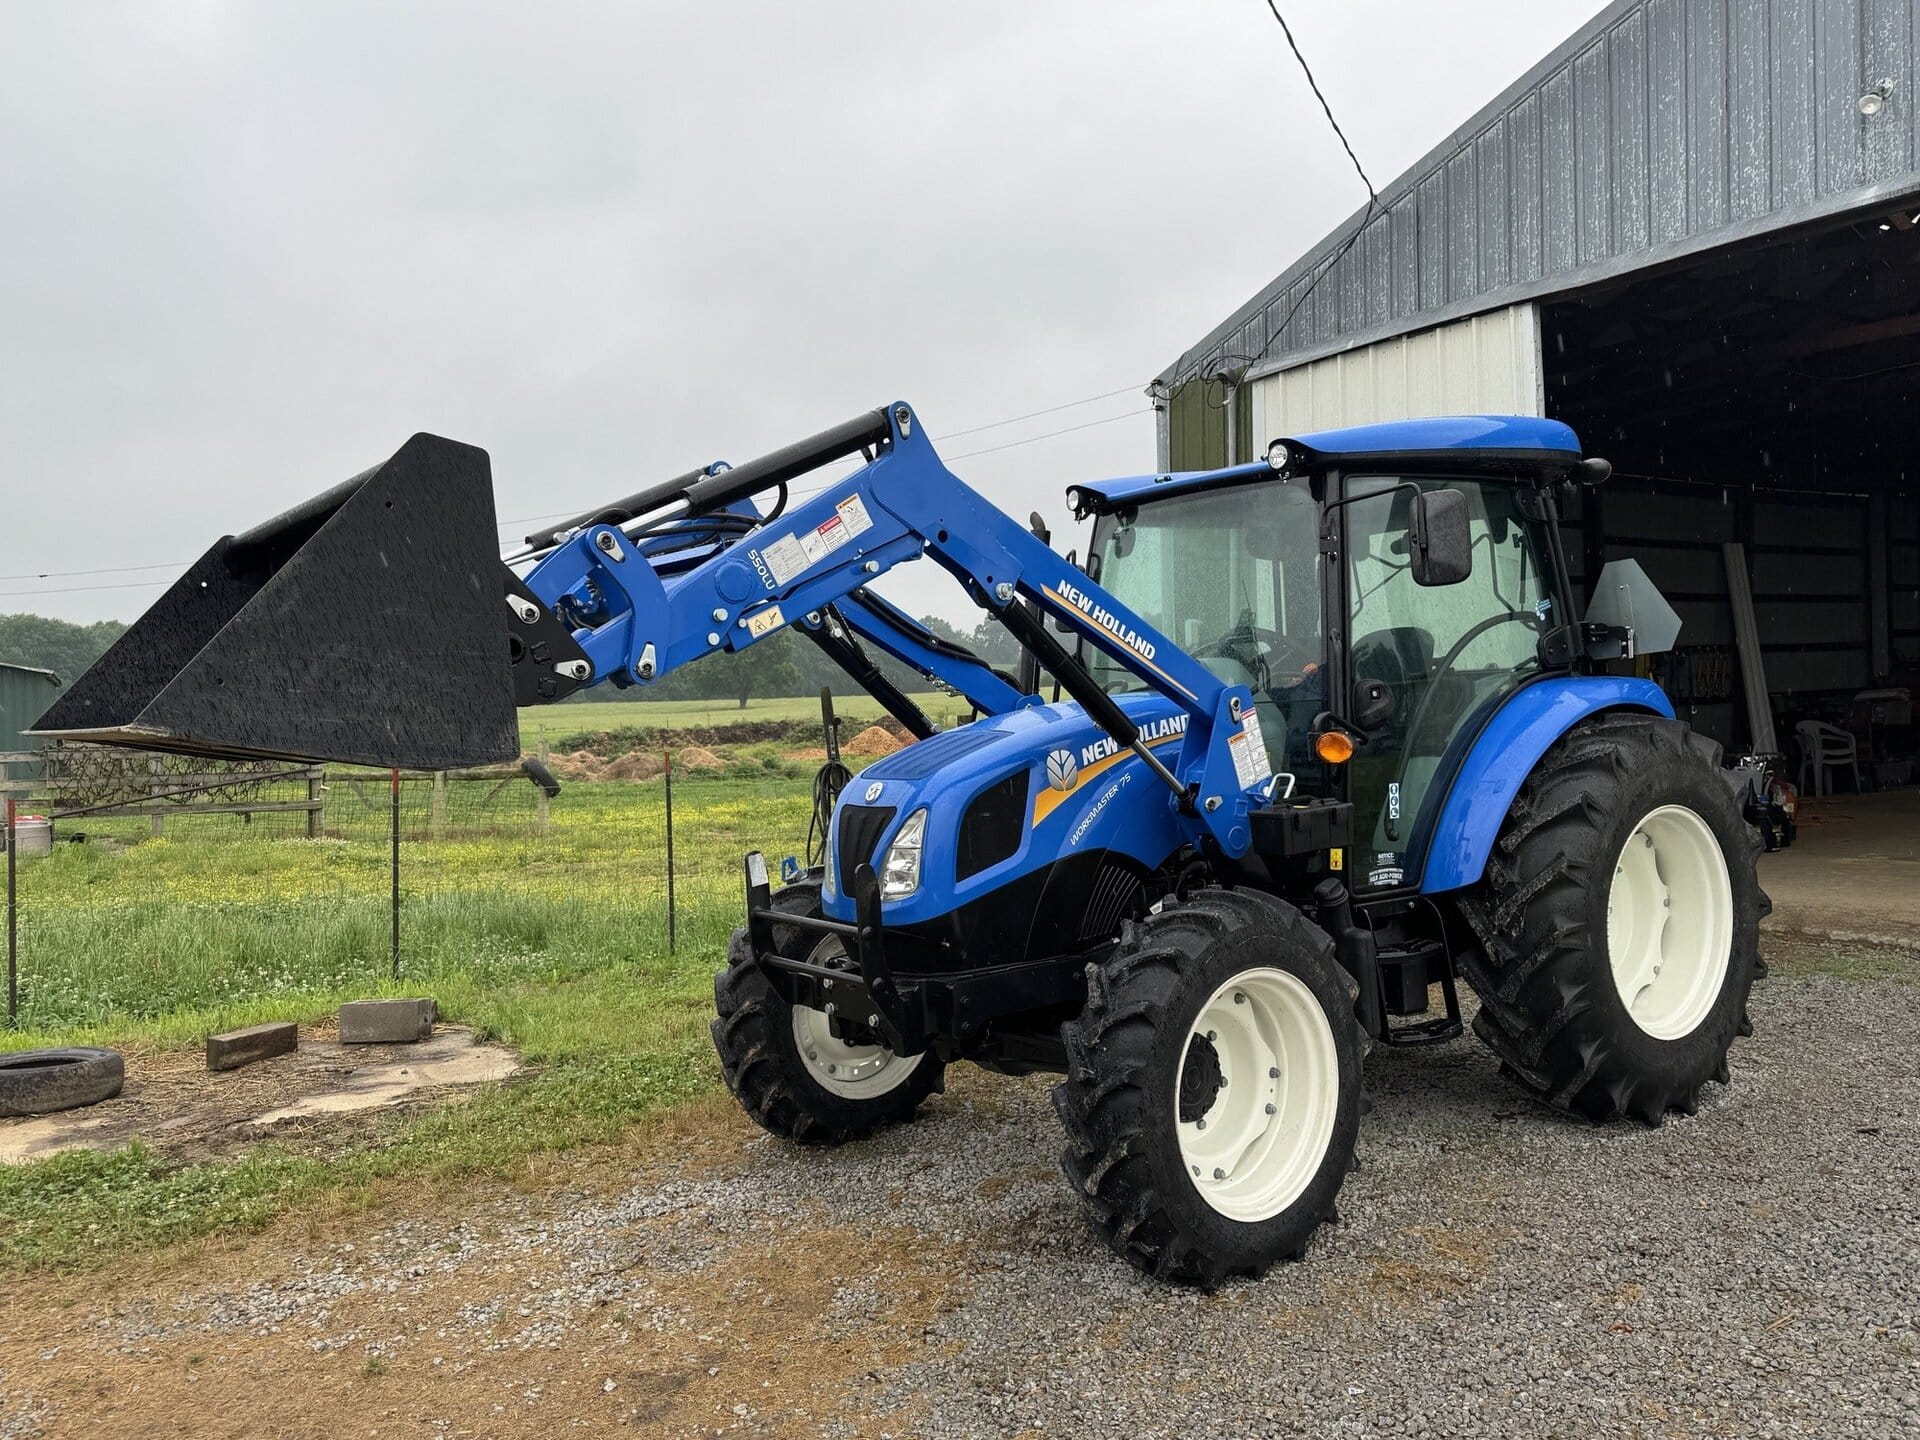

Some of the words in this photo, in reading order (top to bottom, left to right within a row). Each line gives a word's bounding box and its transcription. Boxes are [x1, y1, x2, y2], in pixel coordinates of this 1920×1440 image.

[1057, 579, 1093, 612] NEW
[1092, 605, 1156, 660] HOLLAND
[1081, 736, 1118, 766] NEW
[1070, 784, 1119, 846] WORKMASTER
[1119, 772, 1132, 788] 75
